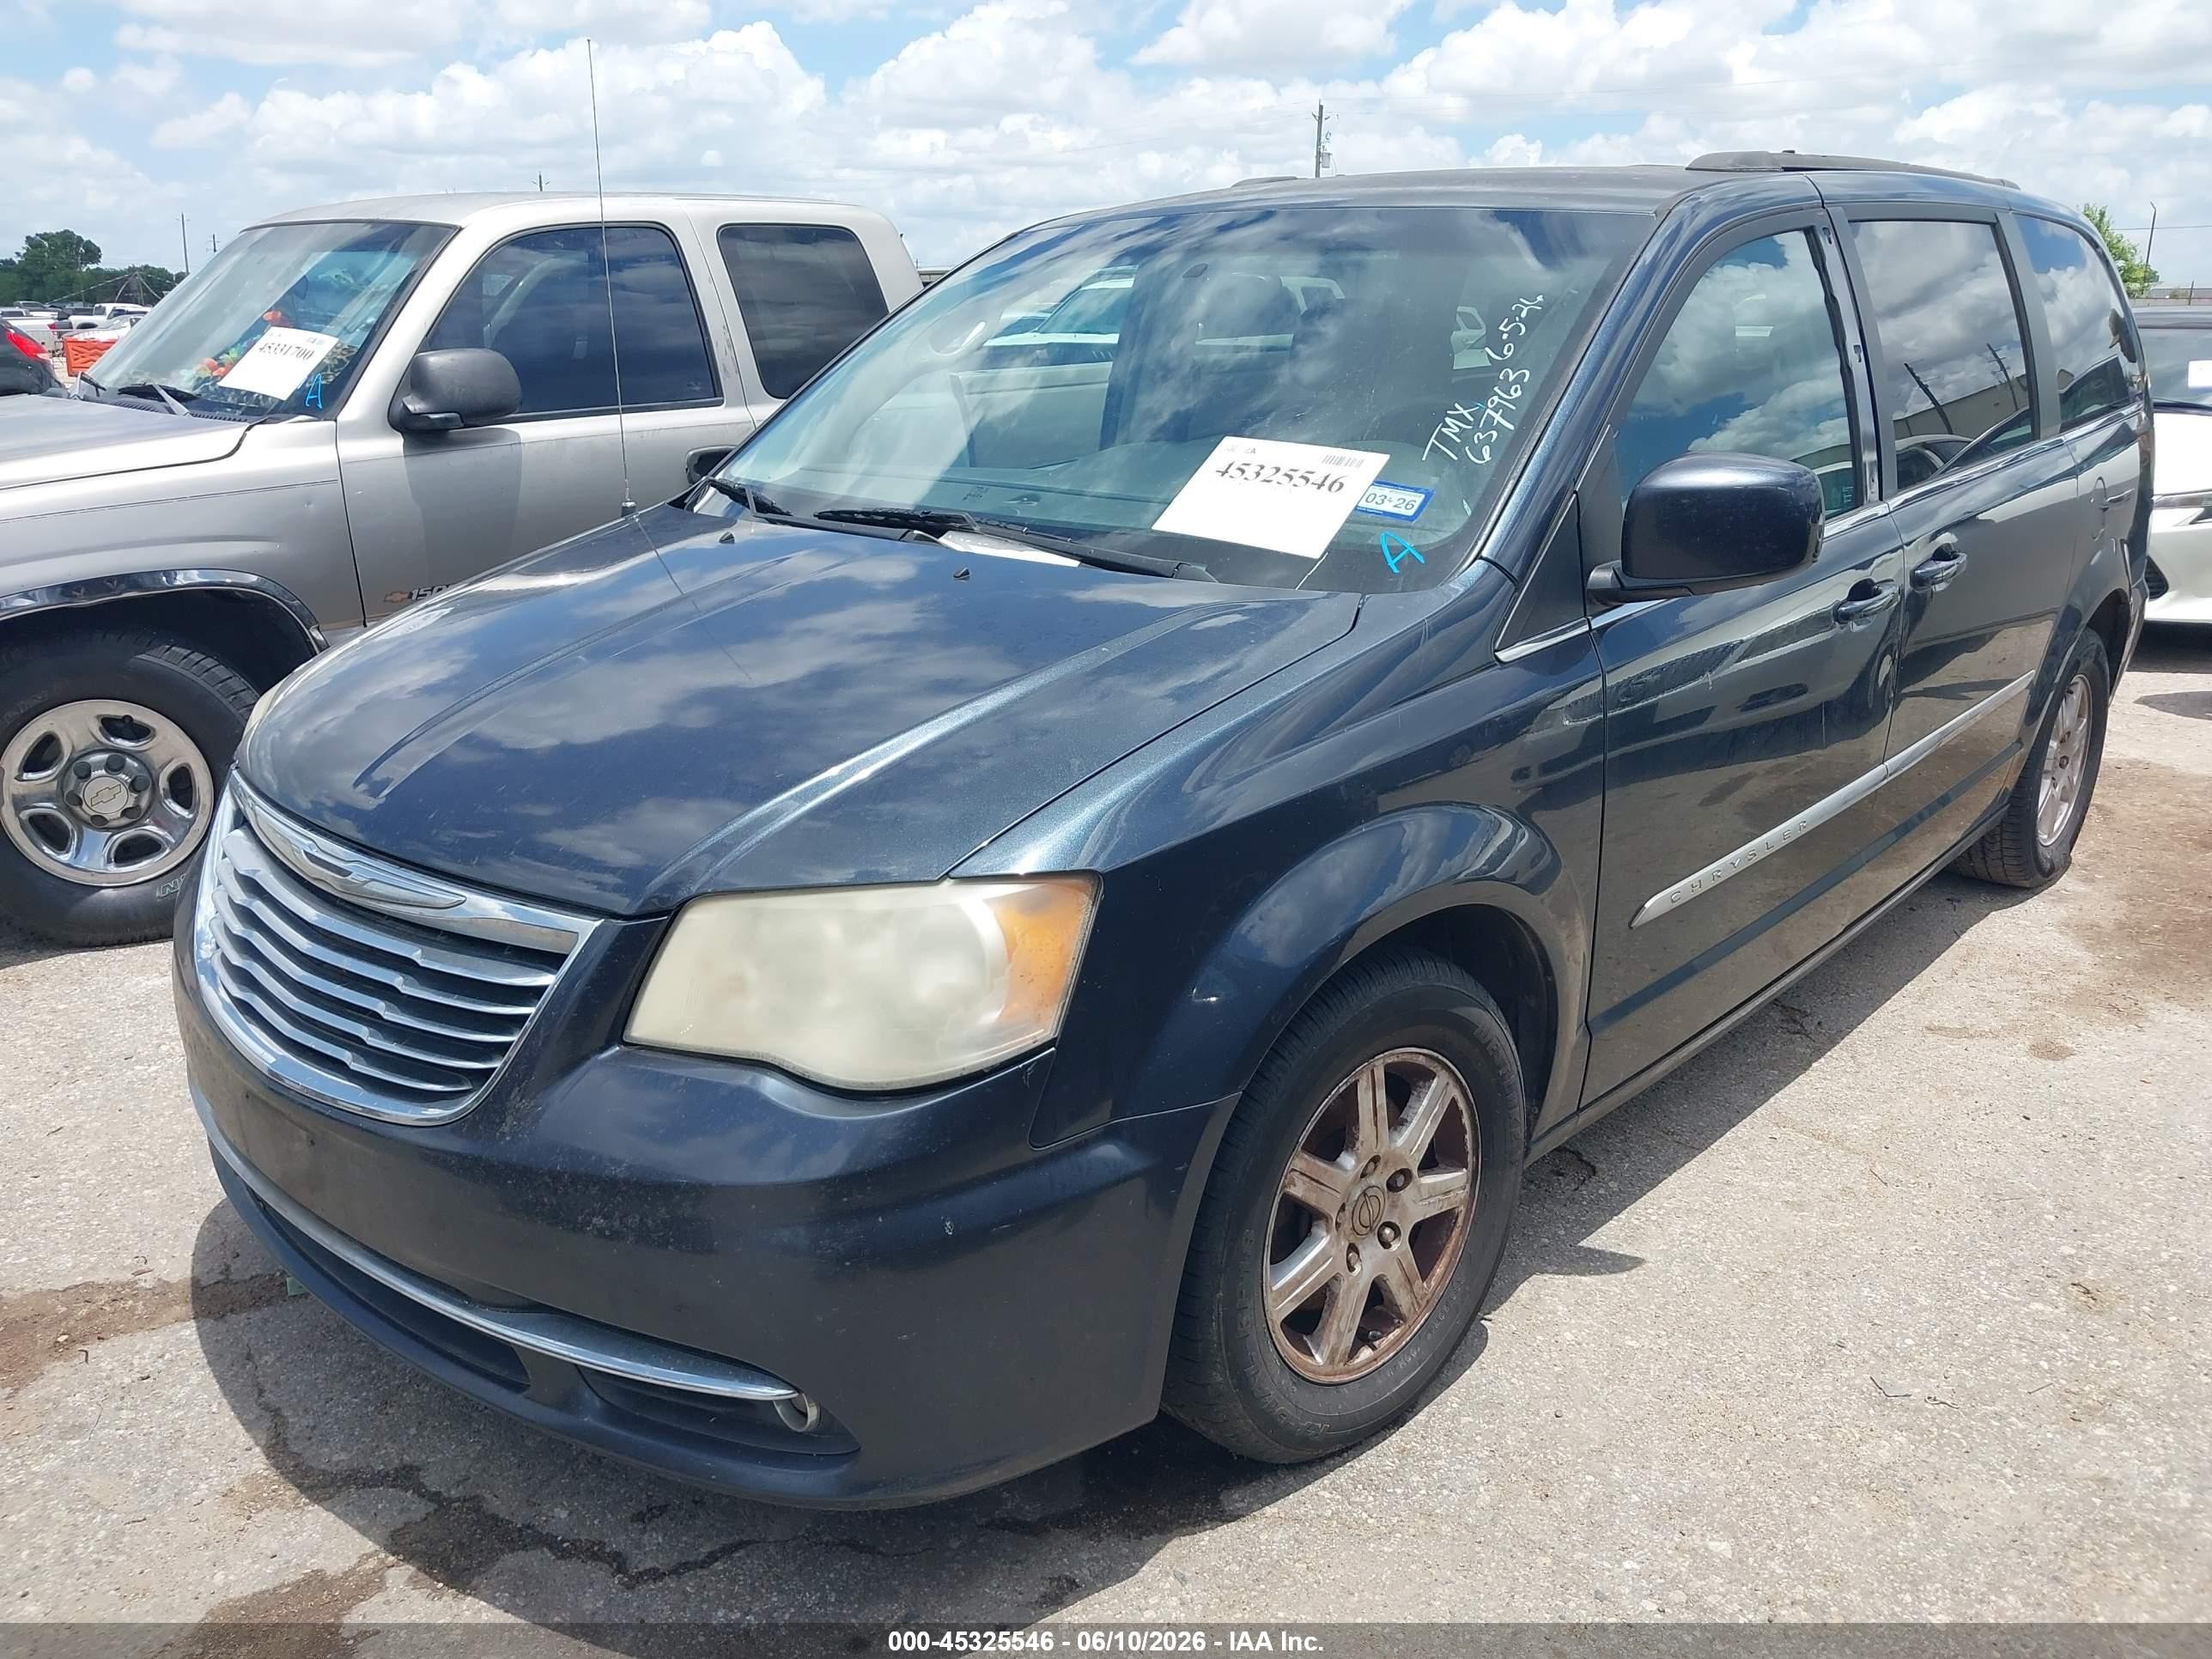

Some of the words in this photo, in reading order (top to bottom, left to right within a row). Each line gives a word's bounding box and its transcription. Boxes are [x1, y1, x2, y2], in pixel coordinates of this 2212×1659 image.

[258, 342, 316, 361] 45331700
[305, 373, 323, 410] A
[1422, 403, 1480, 461] TMX
[1465, 368, 1530, 464] 637963
[1215, 460, 1349, 494] 45325546
[1380, 531, 1425, 574] A
[411, 584, 453, 601] 150
[1670, 819, 1808, 904] CHRYSLER
